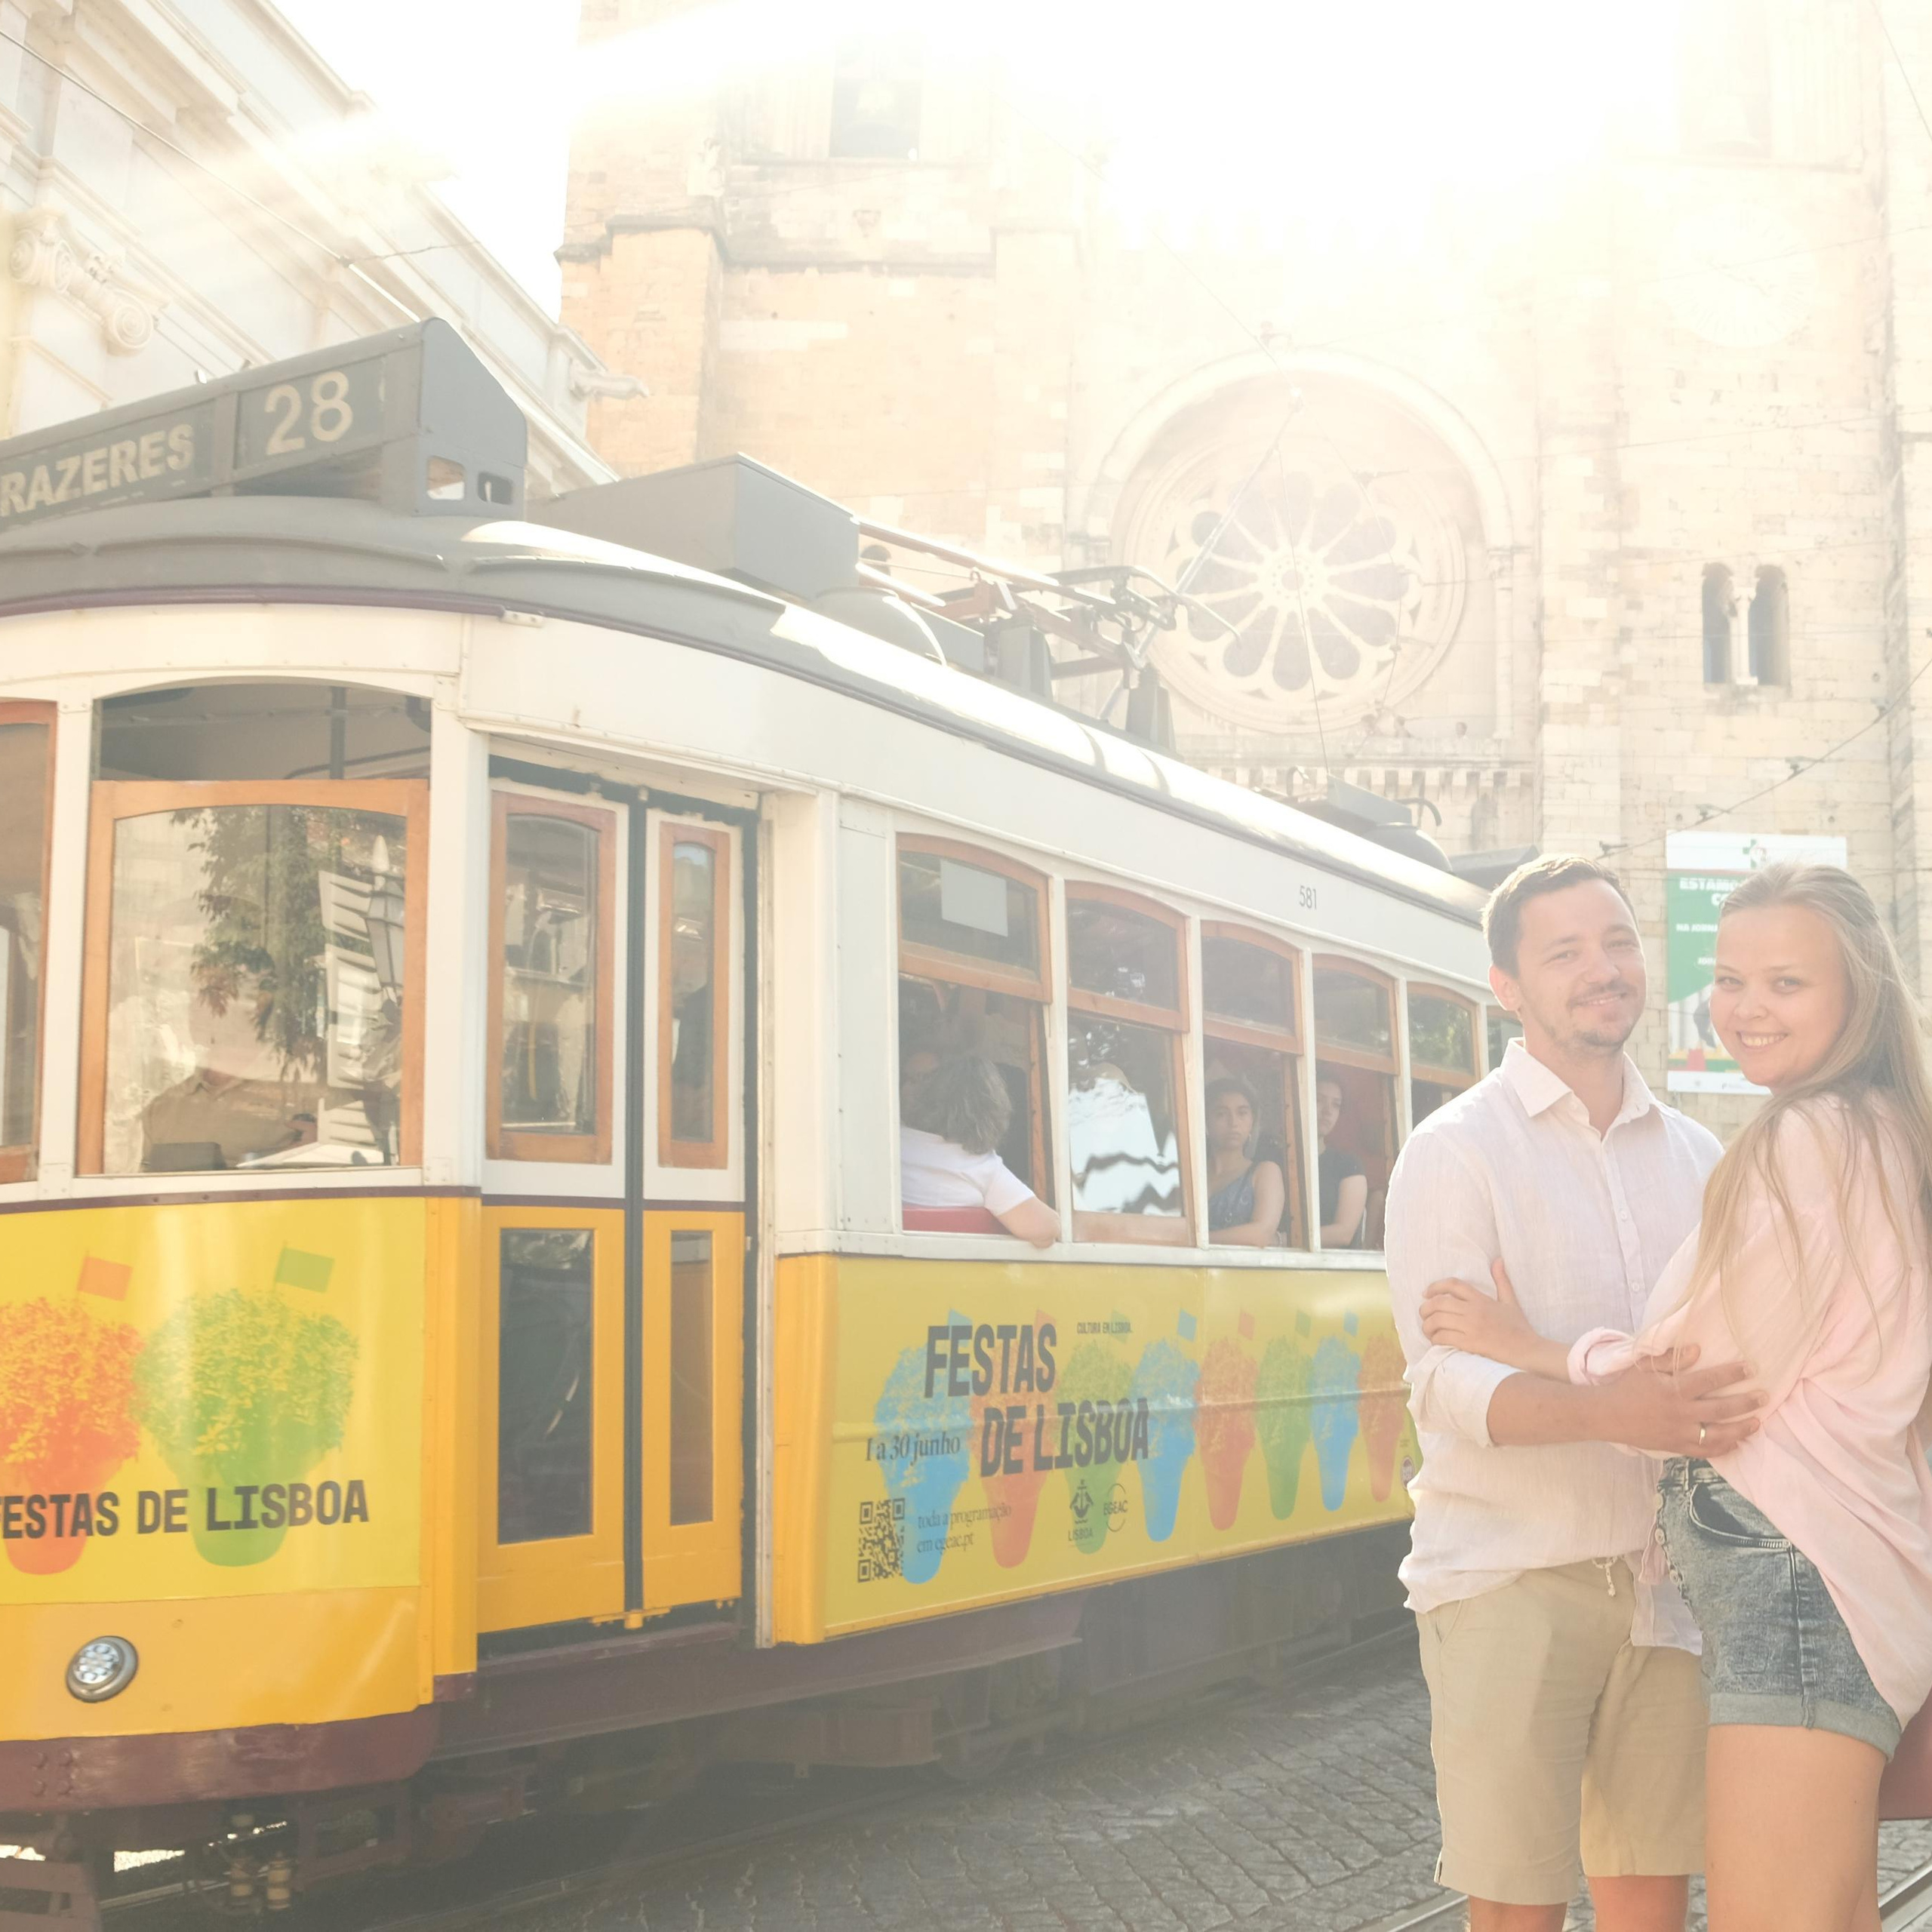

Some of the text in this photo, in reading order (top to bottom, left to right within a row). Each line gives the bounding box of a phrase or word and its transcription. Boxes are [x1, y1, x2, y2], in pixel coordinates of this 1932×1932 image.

[265, 371, 353, 454] 28
[0, 424, 194, 516] RAZERES
[1299, 884, 1317, 910] 581
[1679, 877, 1740, 892] ESTAMO
[924, 1323, 1057, 1398] FESTAS
[876, 1442, 886, 1460] a
[890, 1434, 910, 1460] 30
[910, 1432, 961, 1466] junho
[980, 1397, 1149, 1478] DE LISBOA
[0, 1480, 369, 1539] ESTAS DE LISBOA
